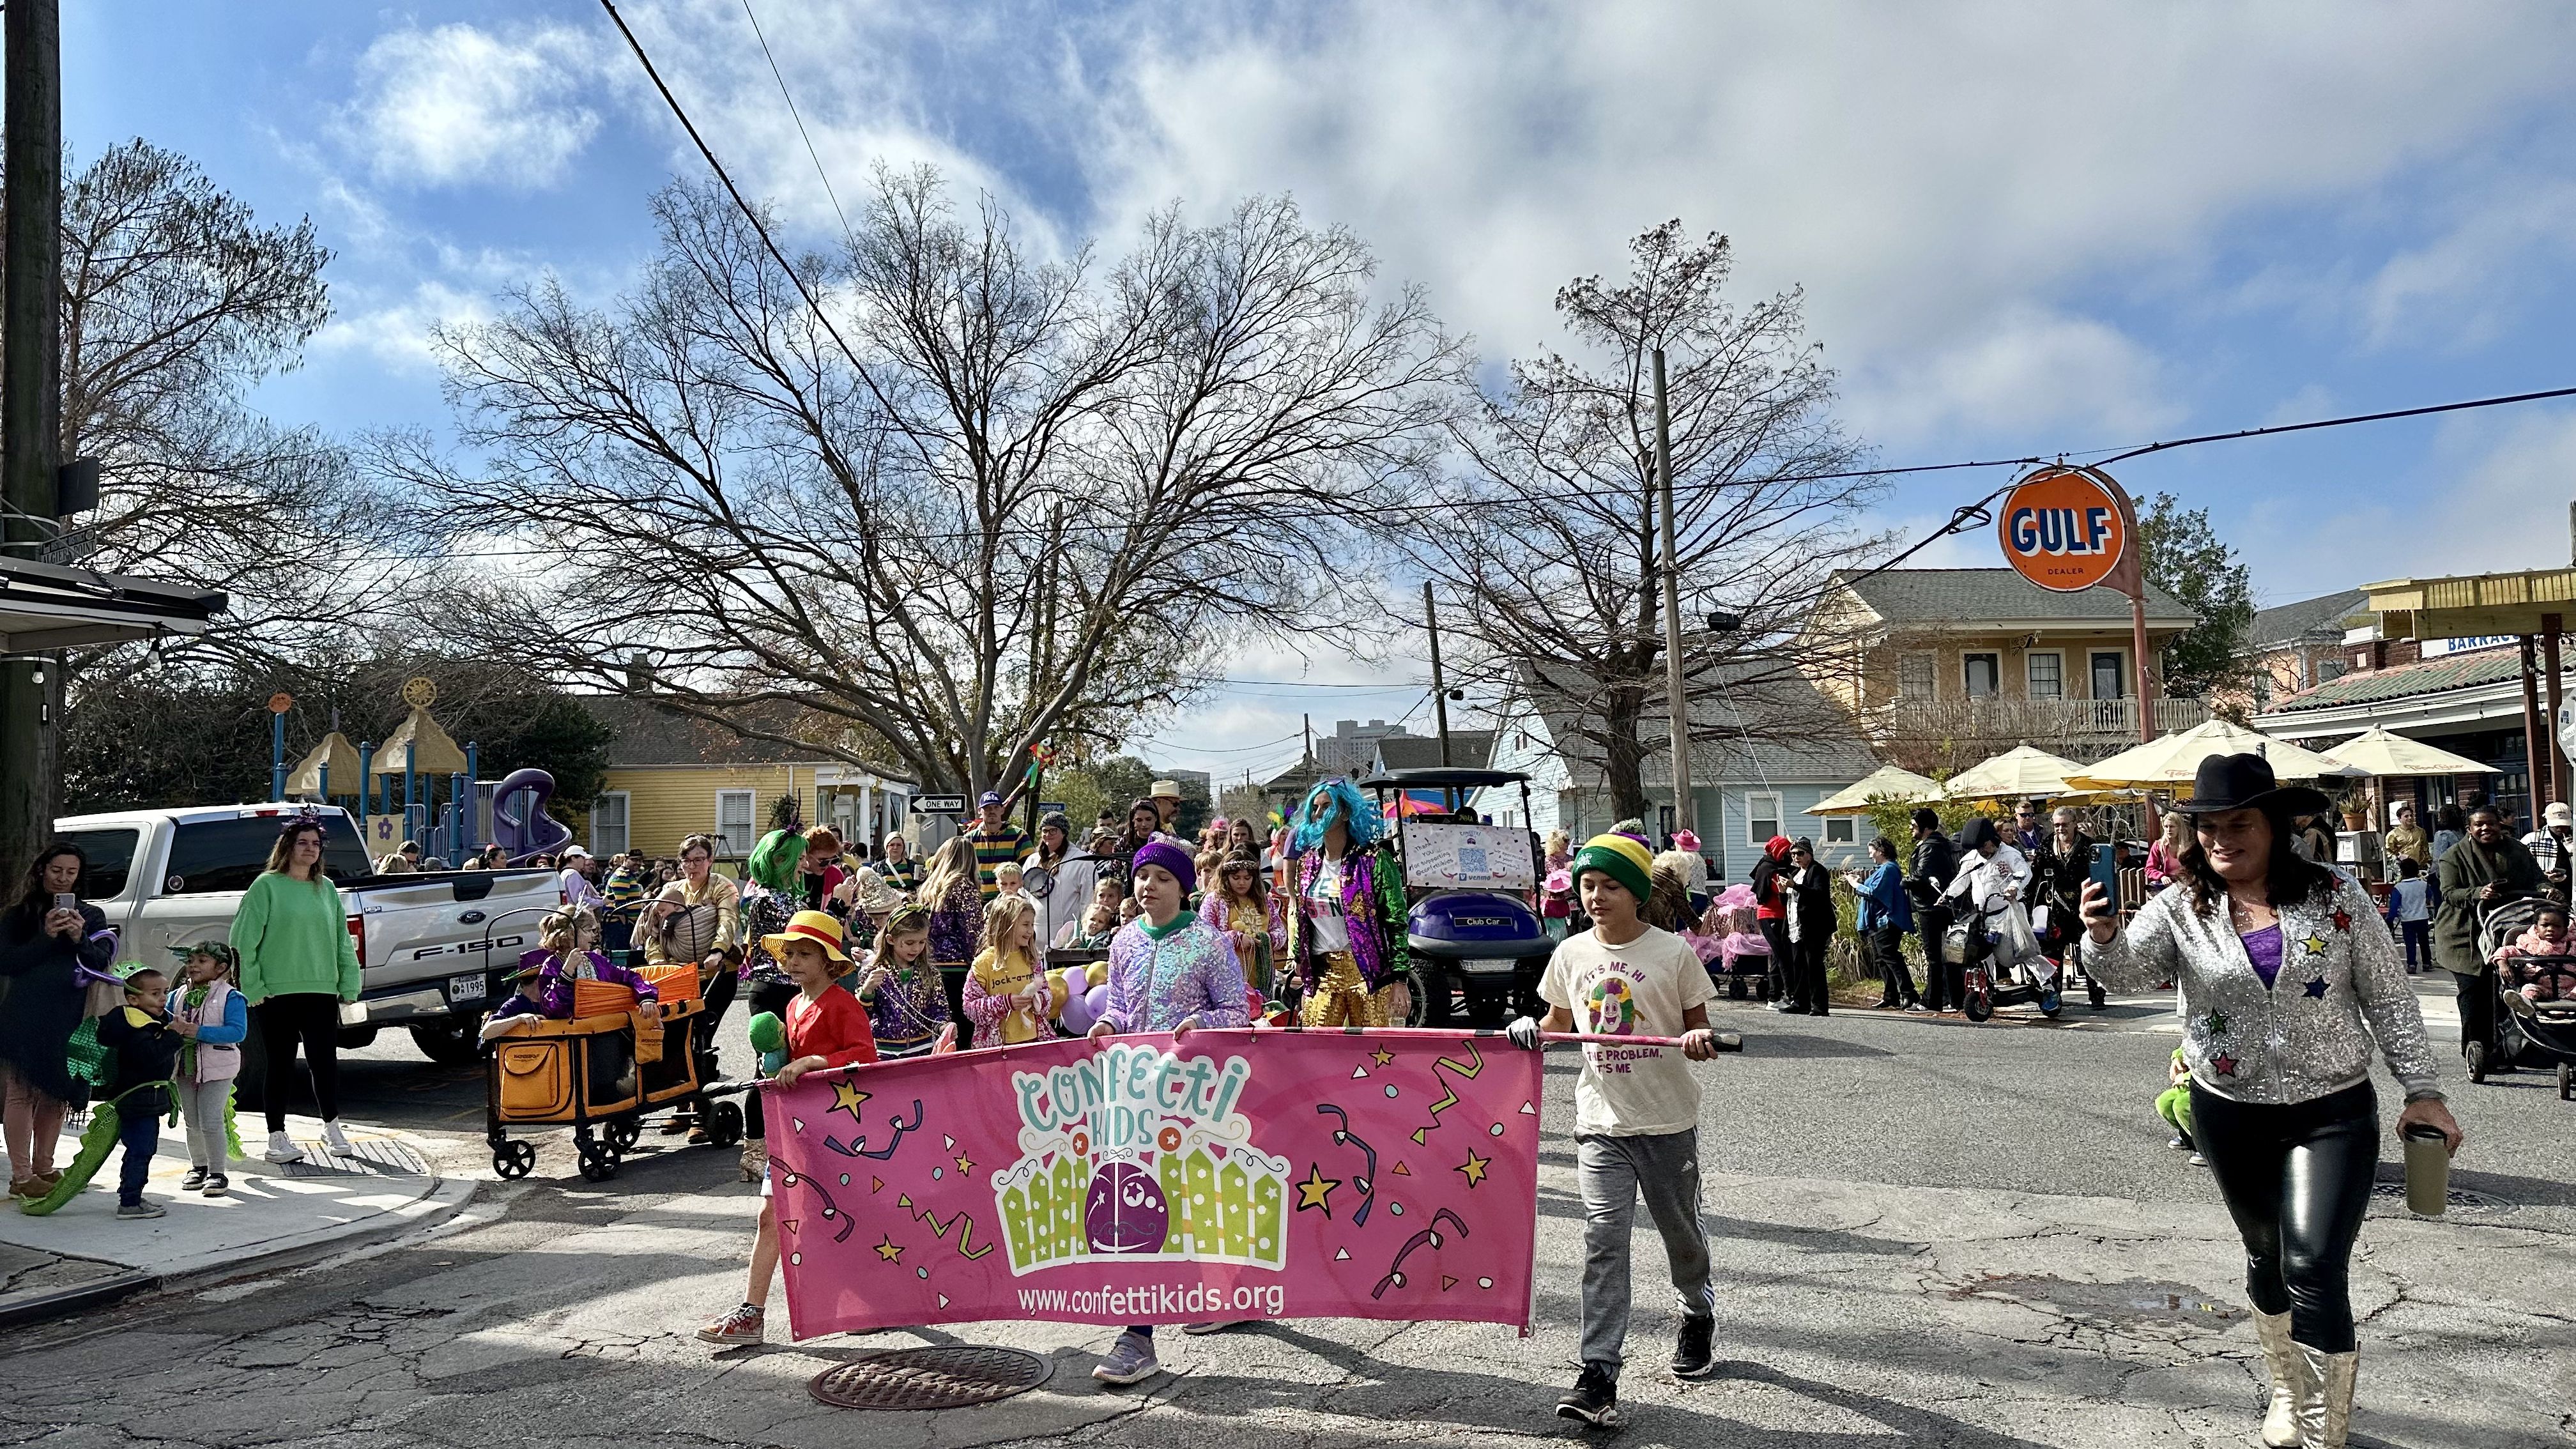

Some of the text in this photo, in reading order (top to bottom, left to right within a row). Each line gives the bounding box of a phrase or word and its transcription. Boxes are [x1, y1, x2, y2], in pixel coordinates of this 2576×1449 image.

[2011, 507, 2112, 557] GULF
[414, 936, 523, 960] F-150
[1584, 962, 1646, 983] IT'S ME, HI
[466, 981, 484, 993] 1995
[1587, 1048, 1662, 1061] THE PROBLEM,
[1616, 1064, 1631, 1073] ME
[1091, 1106, 1154, 1147] KIDS
[1018, 1282, 1285, 1316] www.confettikids.org
